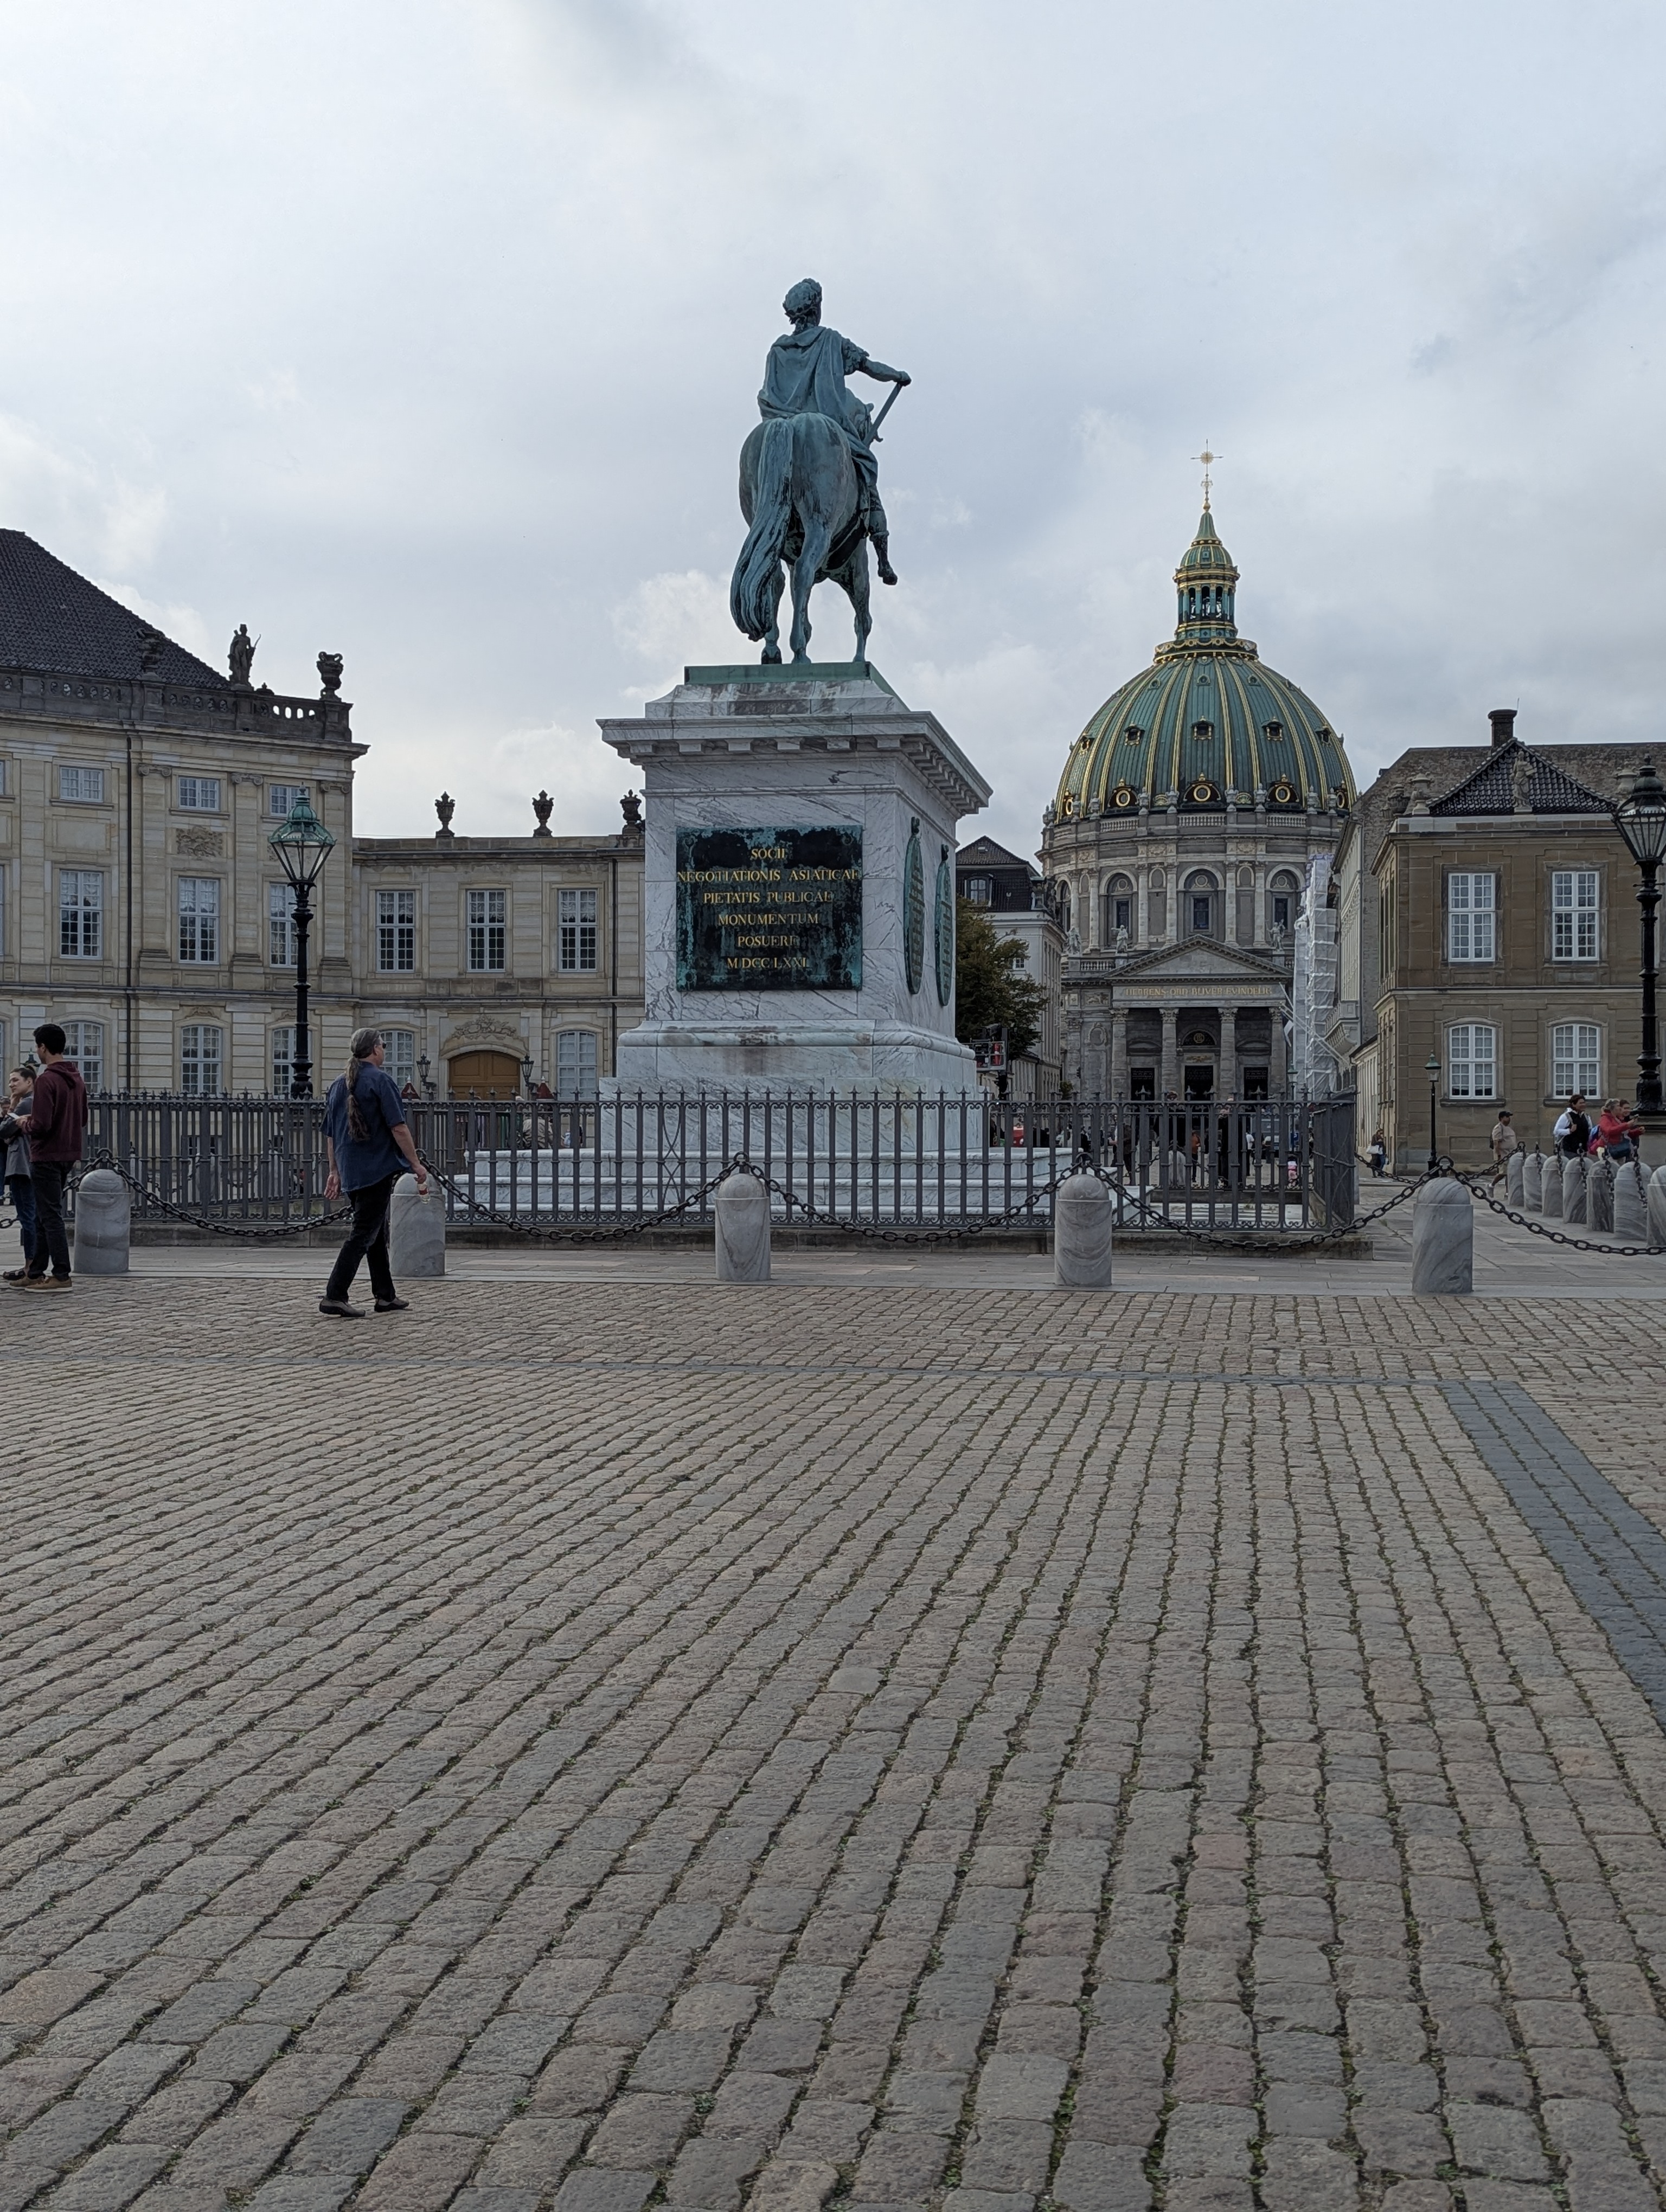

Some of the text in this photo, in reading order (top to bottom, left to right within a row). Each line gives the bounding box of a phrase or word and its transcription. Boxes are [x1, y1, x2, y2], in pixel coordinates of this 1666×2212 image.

[751, 848, 785, 859] SOCII
[677, 870, 781, 882] NEGOTIATIONIS
[704, 891, 833, 904] PIETATIS PUBLICAE
[718, 913, 819, 925] MONUMENTUM
